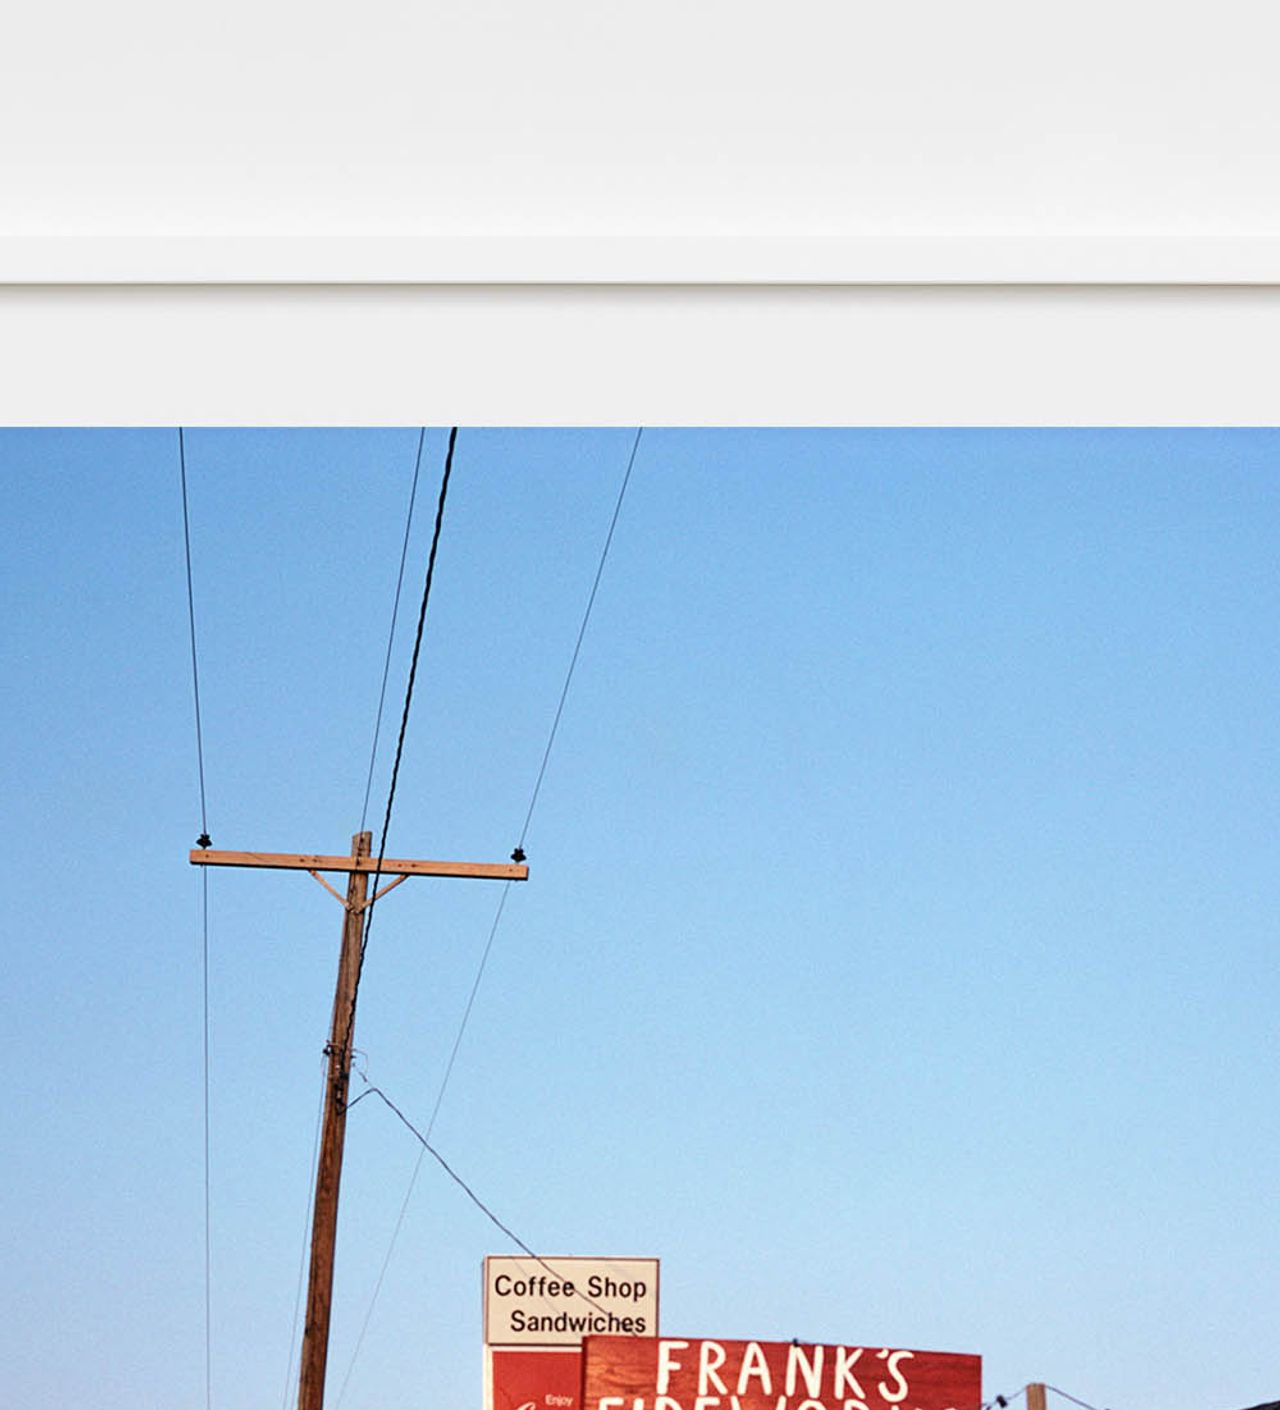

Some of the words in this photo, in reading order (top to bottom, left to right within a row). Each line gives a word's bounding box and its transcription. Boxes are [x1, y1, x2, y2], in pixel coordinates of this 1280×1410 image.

[494, 1274, 574, 1298] Coffee
[587, 1274, 648, 1301] Shop
[510, 1309, 647, 1334] Sandwiches
[656, 1340, 914, 1402] FRANK'S
